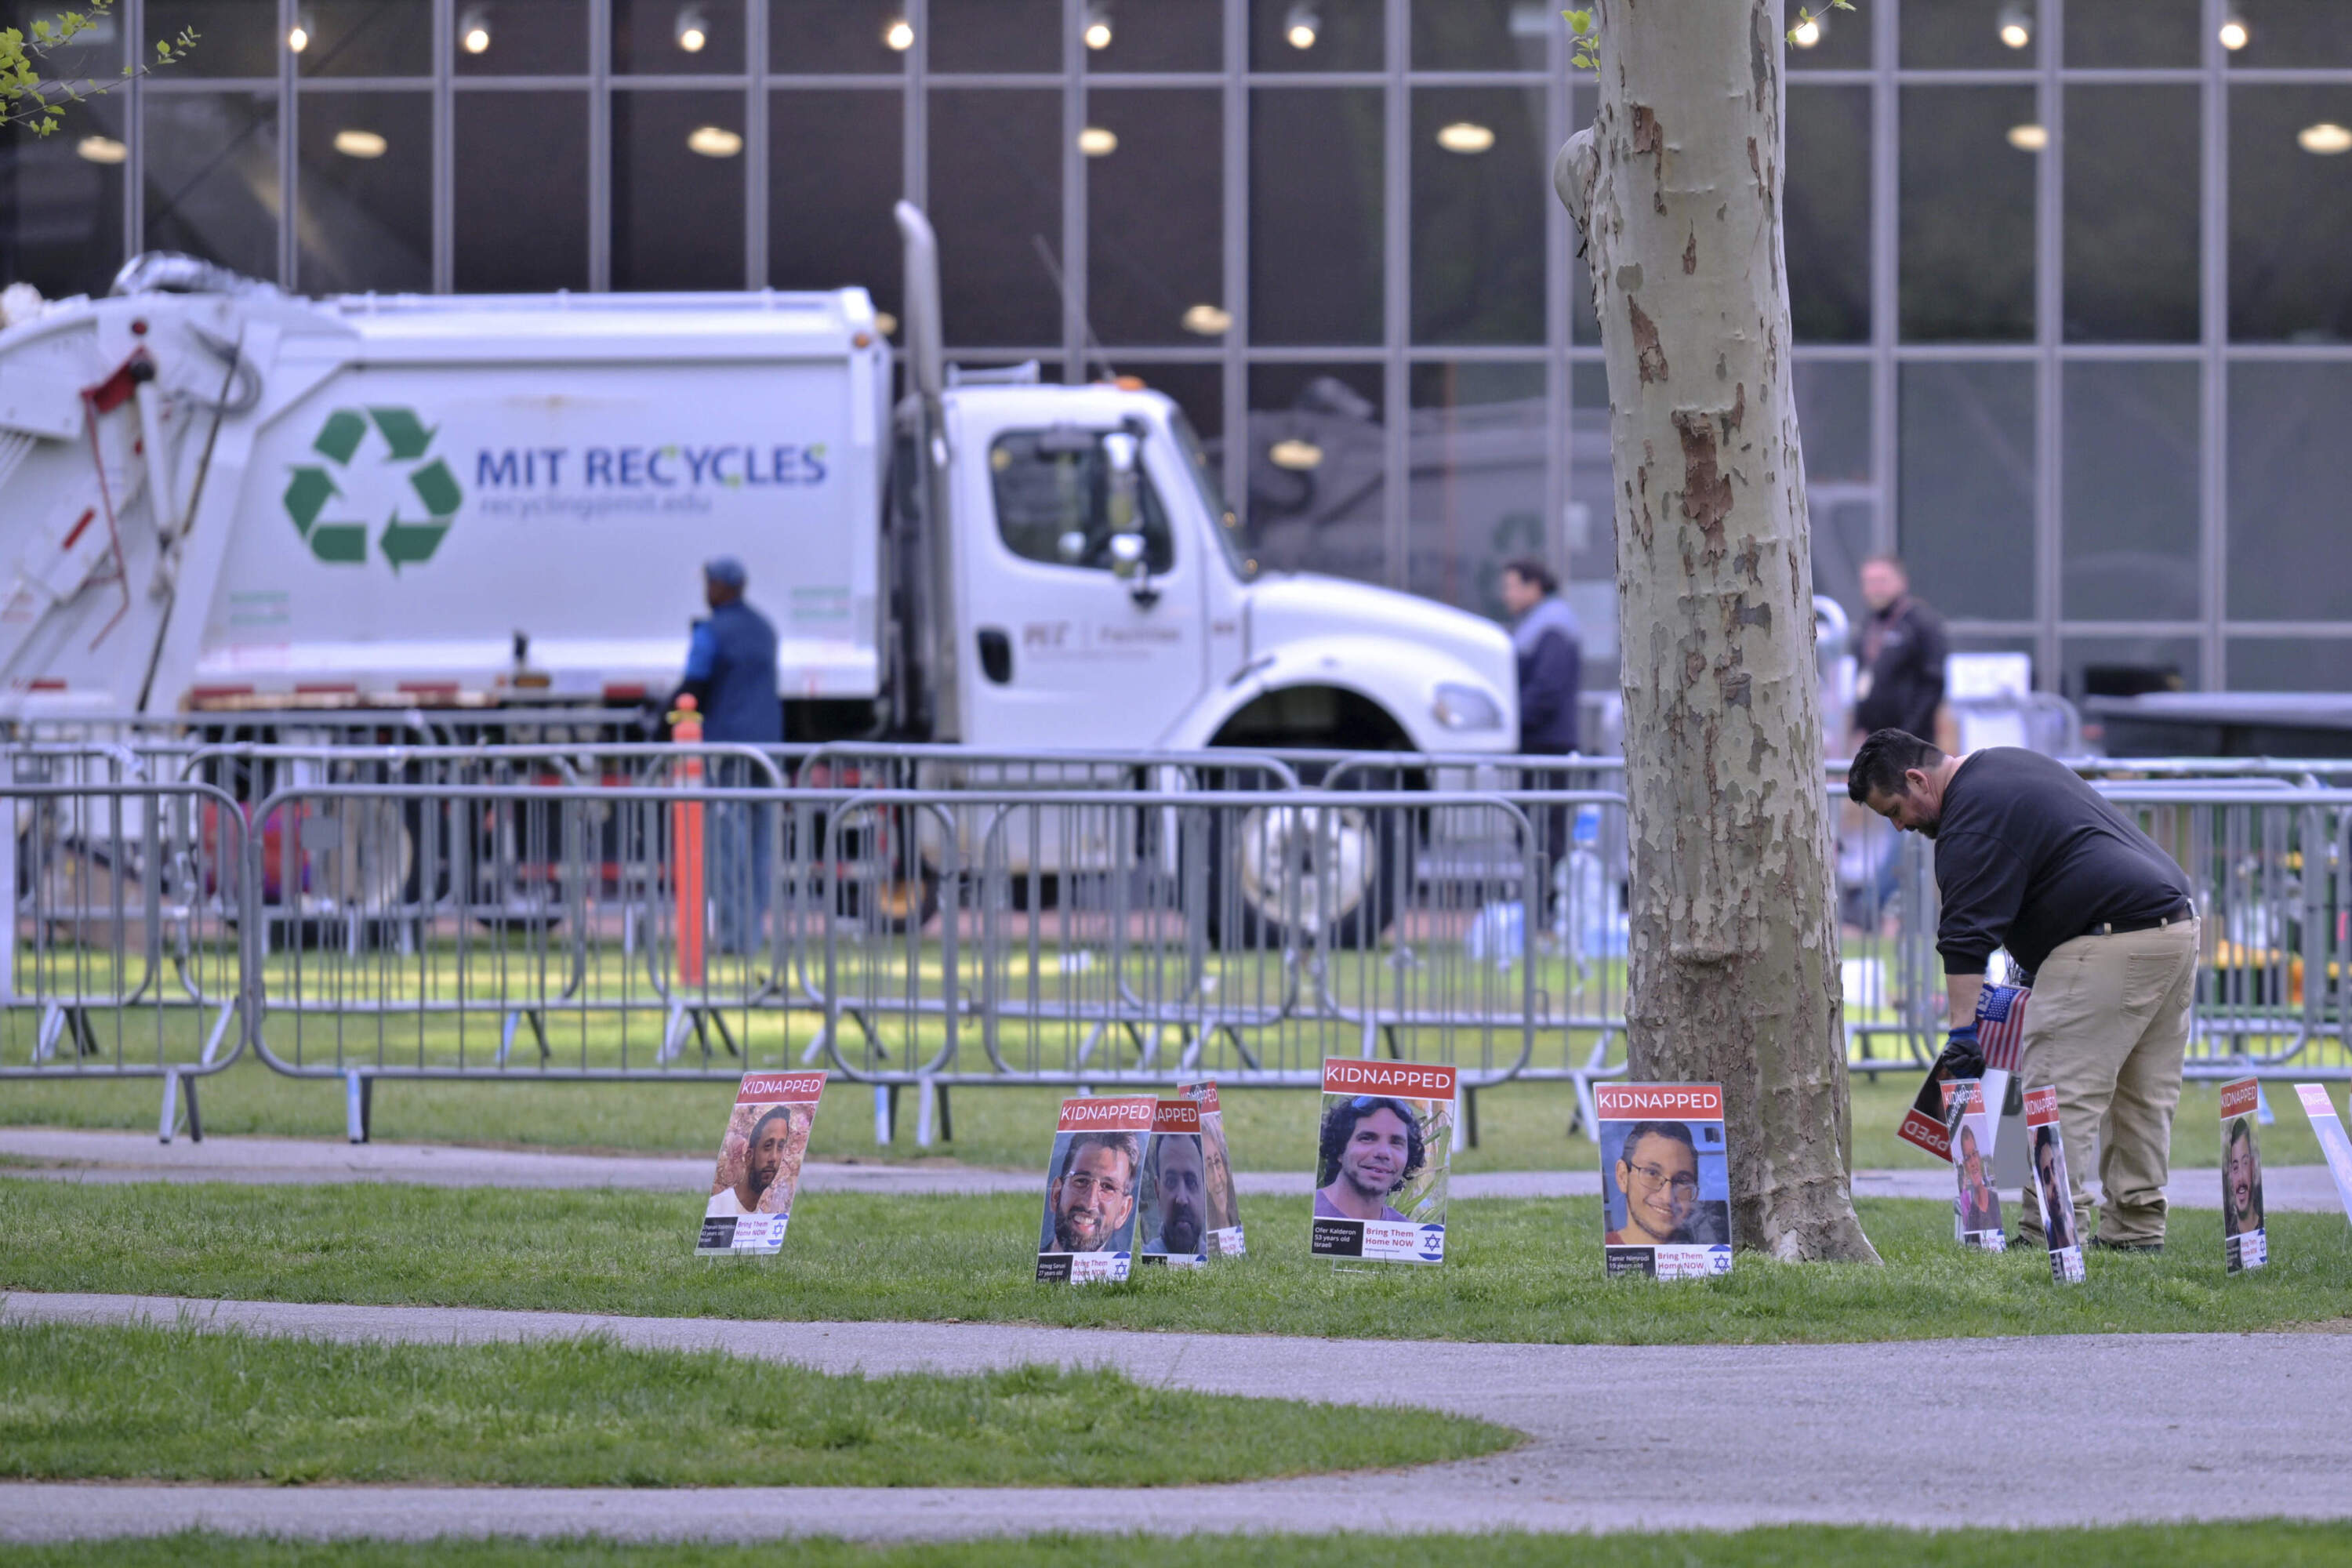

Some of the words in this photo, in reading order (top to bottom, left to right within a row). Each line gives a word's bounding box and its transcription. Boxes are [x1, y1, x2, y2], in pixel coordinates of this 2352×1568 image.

[477, 448, 567, 487] MIT
[584, 444, 828, 488] RECYCLES
[1327, 1066, 1450, 1088] KIDNAPPED
[742, 1079, 820, 1094] KIDNAPPED
[1599, 1094, 1717, 1109] KIDNAPPED
[2221, 1086, 2256, 1110] KIDNAPPED
[1061, 1105, 1151, 1120] KIDNAPPED
[2024, 1096, 2057, 1116] KIDNAPPED
[1367, 1228, 1388, 1237] Bring
[1391, 1229, 1414, 1238] Them
[1366, 1237, 1390, 1246] Home
[1392, 1239, 1414, 1247] NOW
